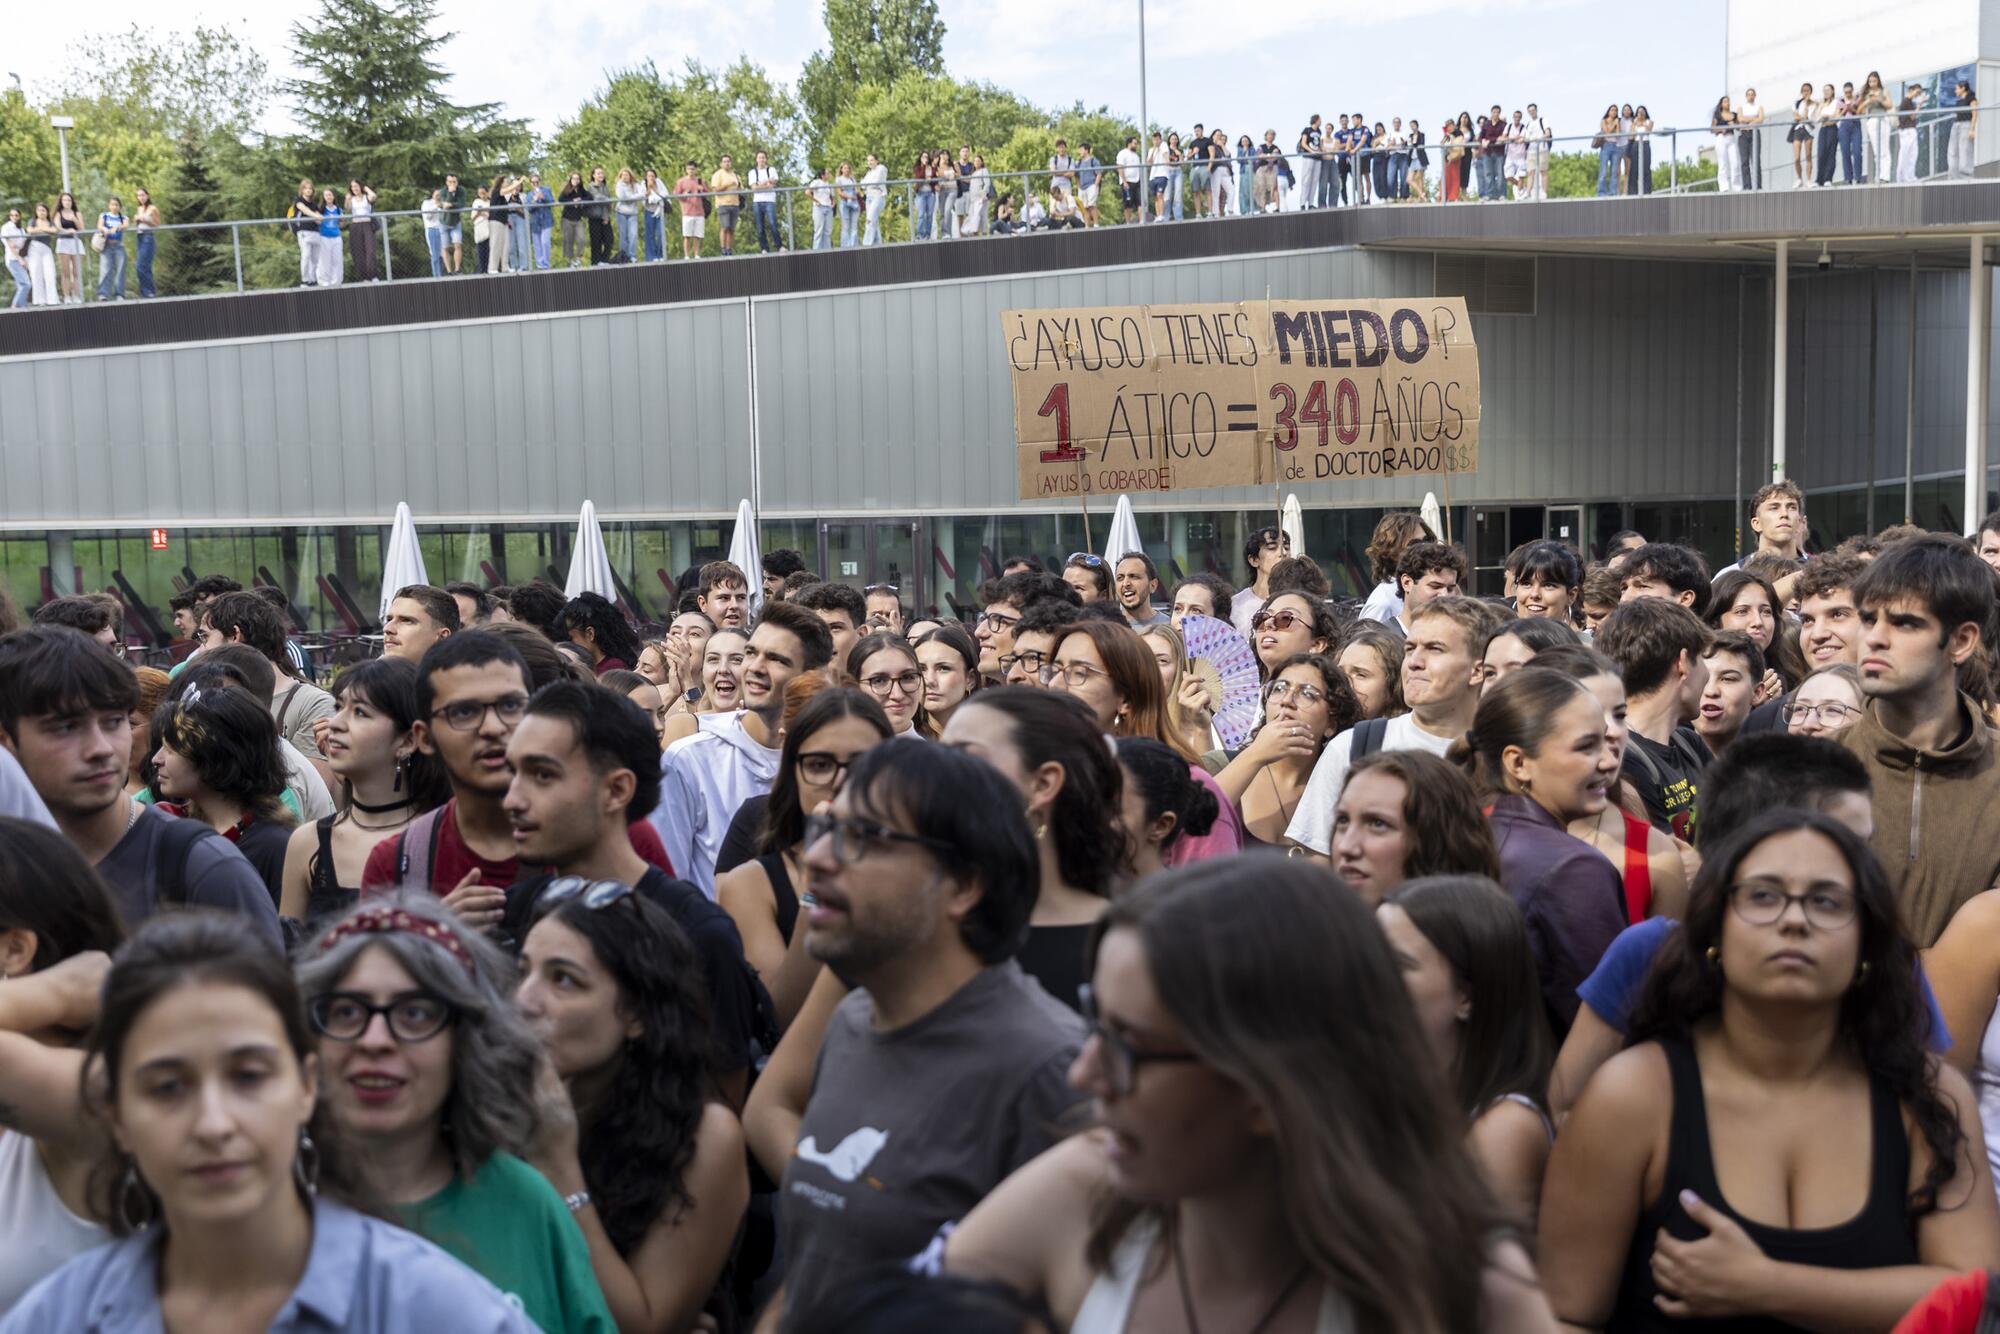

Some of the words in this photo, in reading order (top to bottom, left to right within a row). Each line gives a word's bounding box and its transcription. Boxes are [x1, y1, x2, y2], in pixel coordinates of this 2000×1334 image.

[1011, 314, 1145, 372] ¿AYUSO
[1152, 312, 1258, 367] TIENES
[1037, 382, 1086, 463] 1
[1101, 384, 1217, 462] ÁTICO
[1269, 377, 1361, 451] 340
[1369, 376, 1463, 443] AÑOS
[1285, 456, 1306, 480] de
[1315, 446, 1441, 479] DOCTORADO
